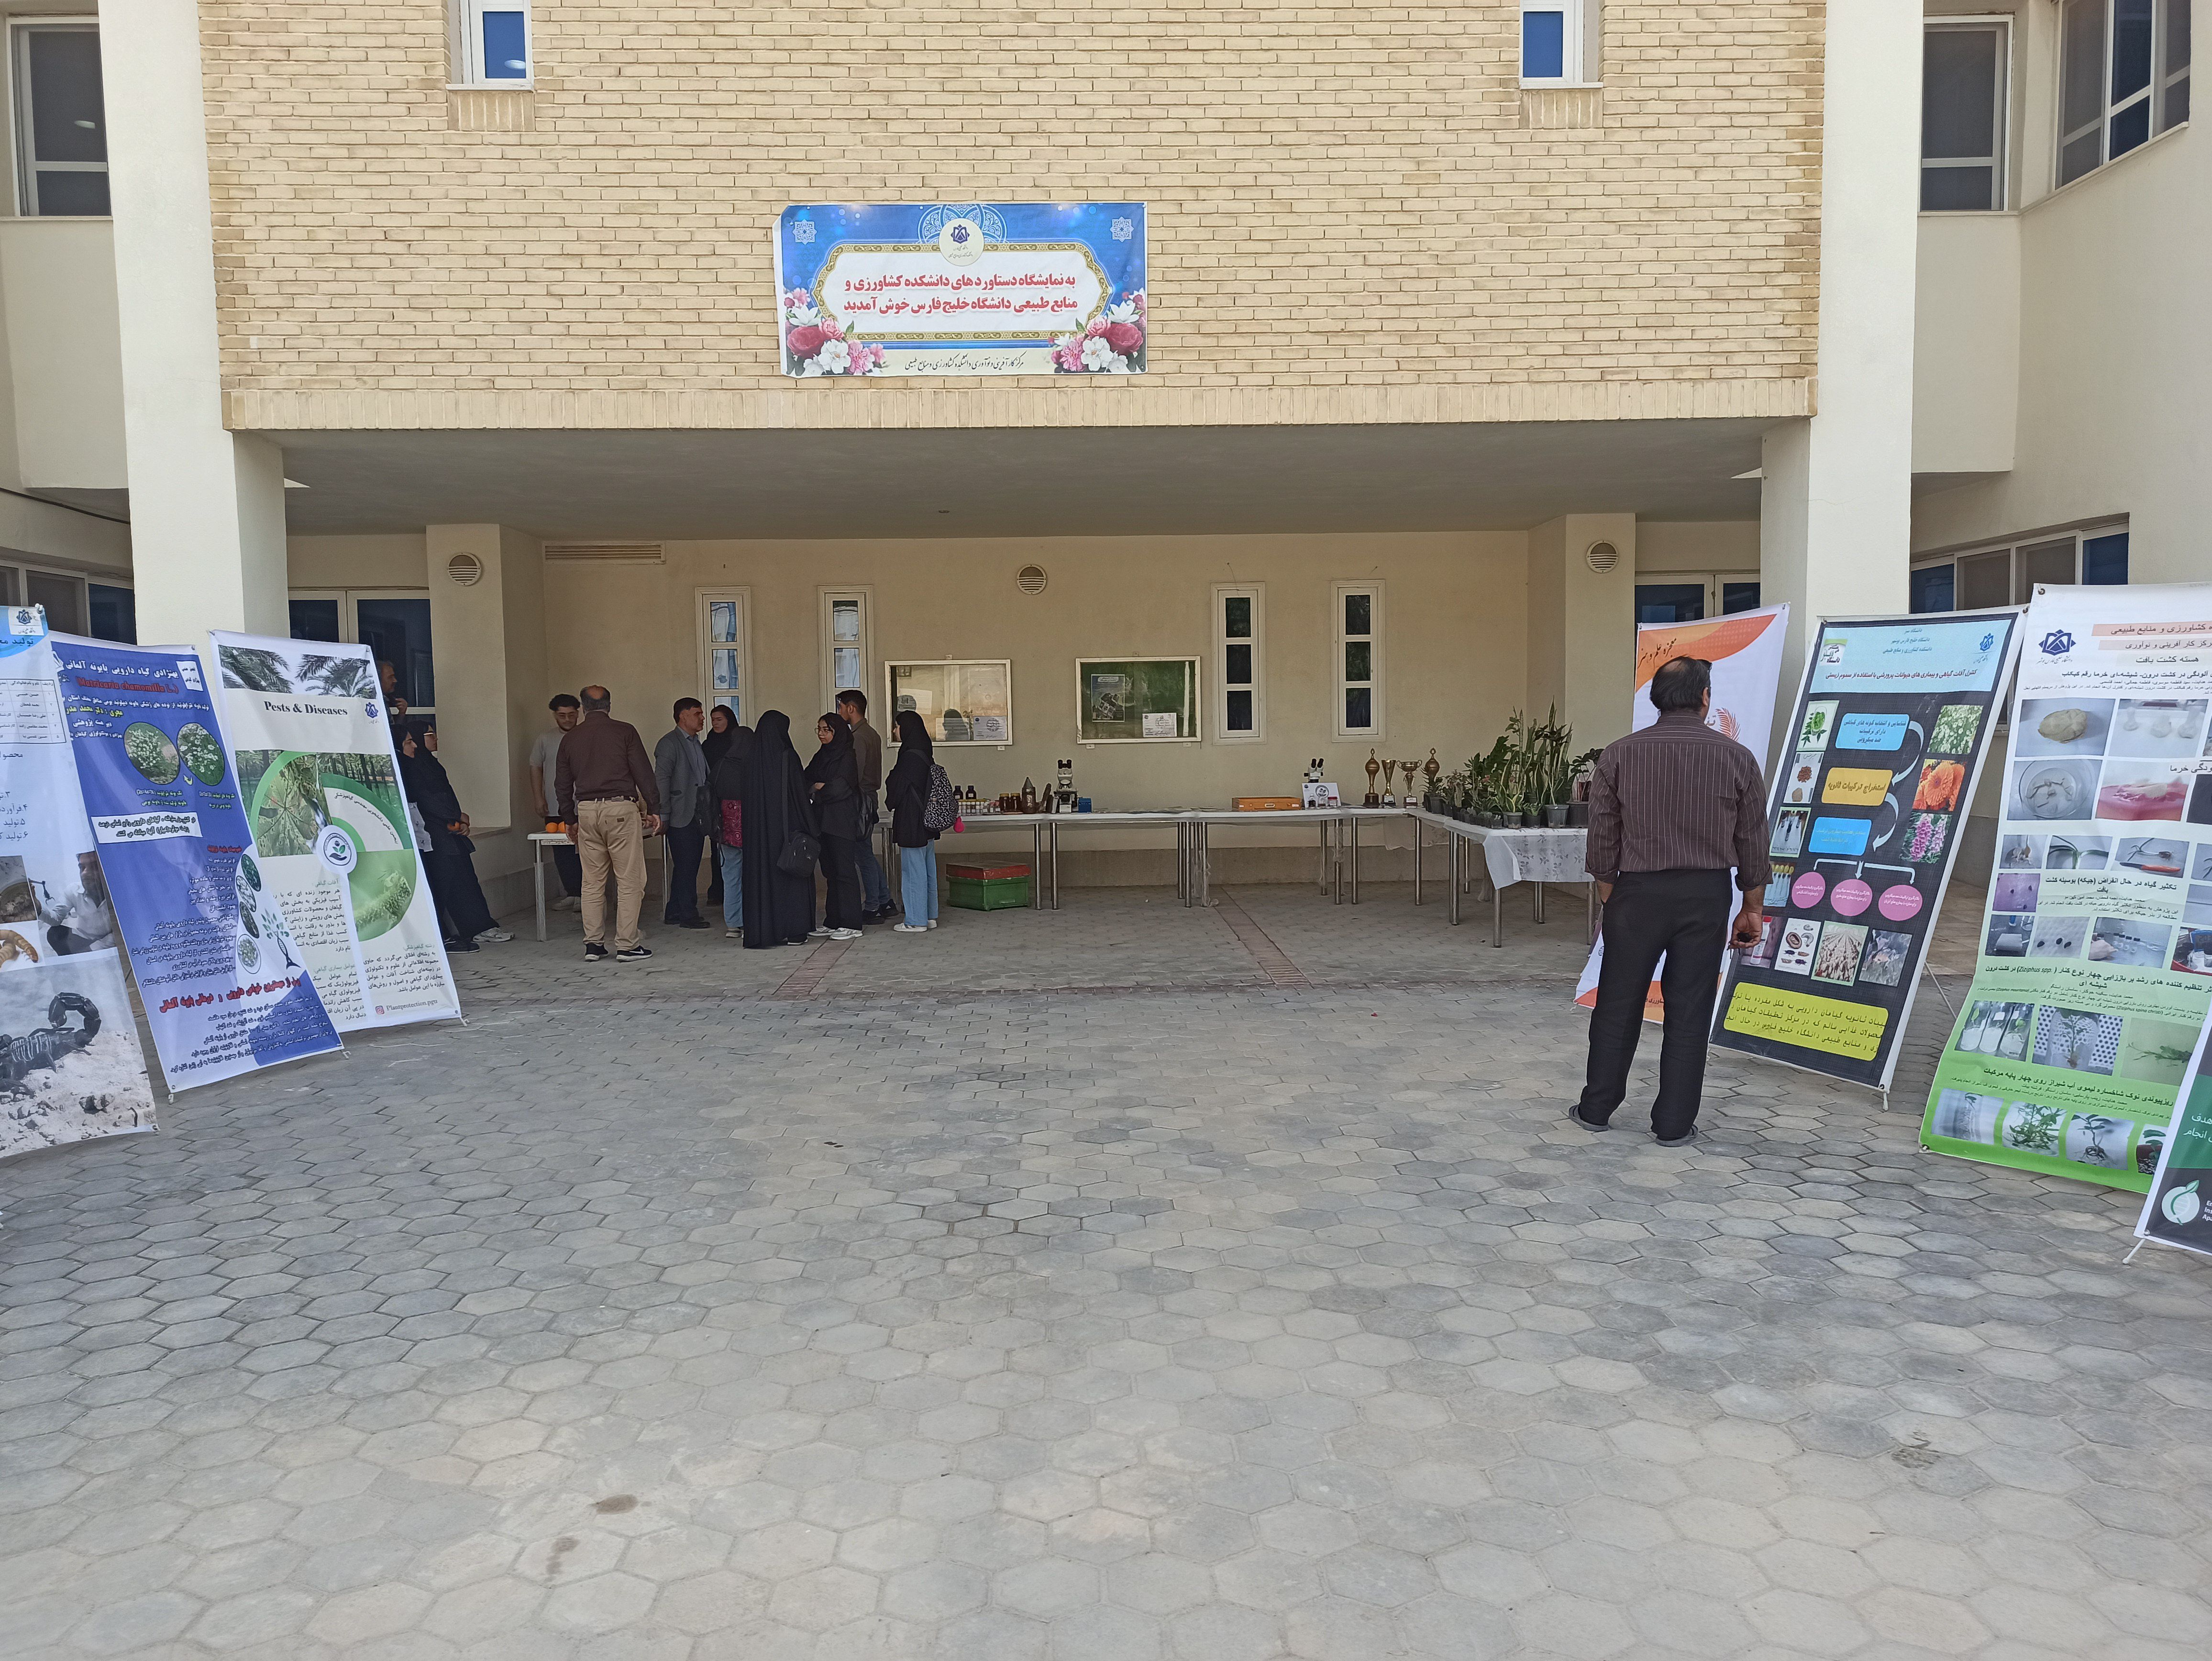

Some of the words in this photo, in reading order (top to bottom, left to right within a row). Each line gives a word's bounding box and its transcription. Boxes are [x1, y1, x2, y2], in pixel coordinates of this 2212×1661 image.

[844, 279, 851, 291] و
[854, 274, 903, 291] کشاورزی
[904, 274, 950, 288] دانشکده
[1018, 273, 1063, 288] نمایشگاه
[1065, 276, 1075, 289] به
[844, 297, 877, 313] آمدید
[879, 299, 909, 313] خوش
[911, 297, 941, 313] فارس
[942, 297, 969, 313] خلیج
[971, 297, 1011, 309] دانشگاه
[1014, 297, 1050, 312] طبیعی
[1051, 297, 1077, 312] منابع
[2111, 625, 2135, 634] طبیعی
[2137, 626, 2156, 635] منابع
[2167, 623, 2206, 632] کشاورزی
[12, 638, 34, 646] تولید
[2125, 641, 2150, 649] نوآوری
[66, 659, 86, 669] آلمانی
[90, 662, 109, 673] بابونه
[112, 665, 135, 675] دارویی
[1939, 670, 1954, 679] گیاهی
[1965, 669, 1978, 677] کنترل
[2187, 670, 2208, 678] آلودگی
[264, 701, 290, 712] Pests
[292, 703, 302, 713] &
[304, 704, 348, 715] Diseases
[2170, 765, 2188, 773] خرما
[1842, 782, 1863, 791] ترکیبات
[1862, 782, 1886, 794] استخراج
[2158, 882, 2176, 890] تکثیر
[294, 932, 306, 941] گیاهی
[365, 965, 384, 973] تکنولوژی
[2086, 971, 2101, 980] چهار
[339, 987, 360, 996] فیزیولوژی
[387, 999, 438, 1011] Plantprotection.pgu
[1736, 1005, 1757, 1014] گیاهان
[1785, 1014, 1799, 1023] مرکز
[1821, 1009, 1843, 1019] گیاهان
[1984, 1068, 2003, 1076] مرکبات
[2005, 1072, 2016, 1080] پایه
[2017, 1074, 2032, 1083] چهار
[2182, 1128, 2208, 1139] انجام
